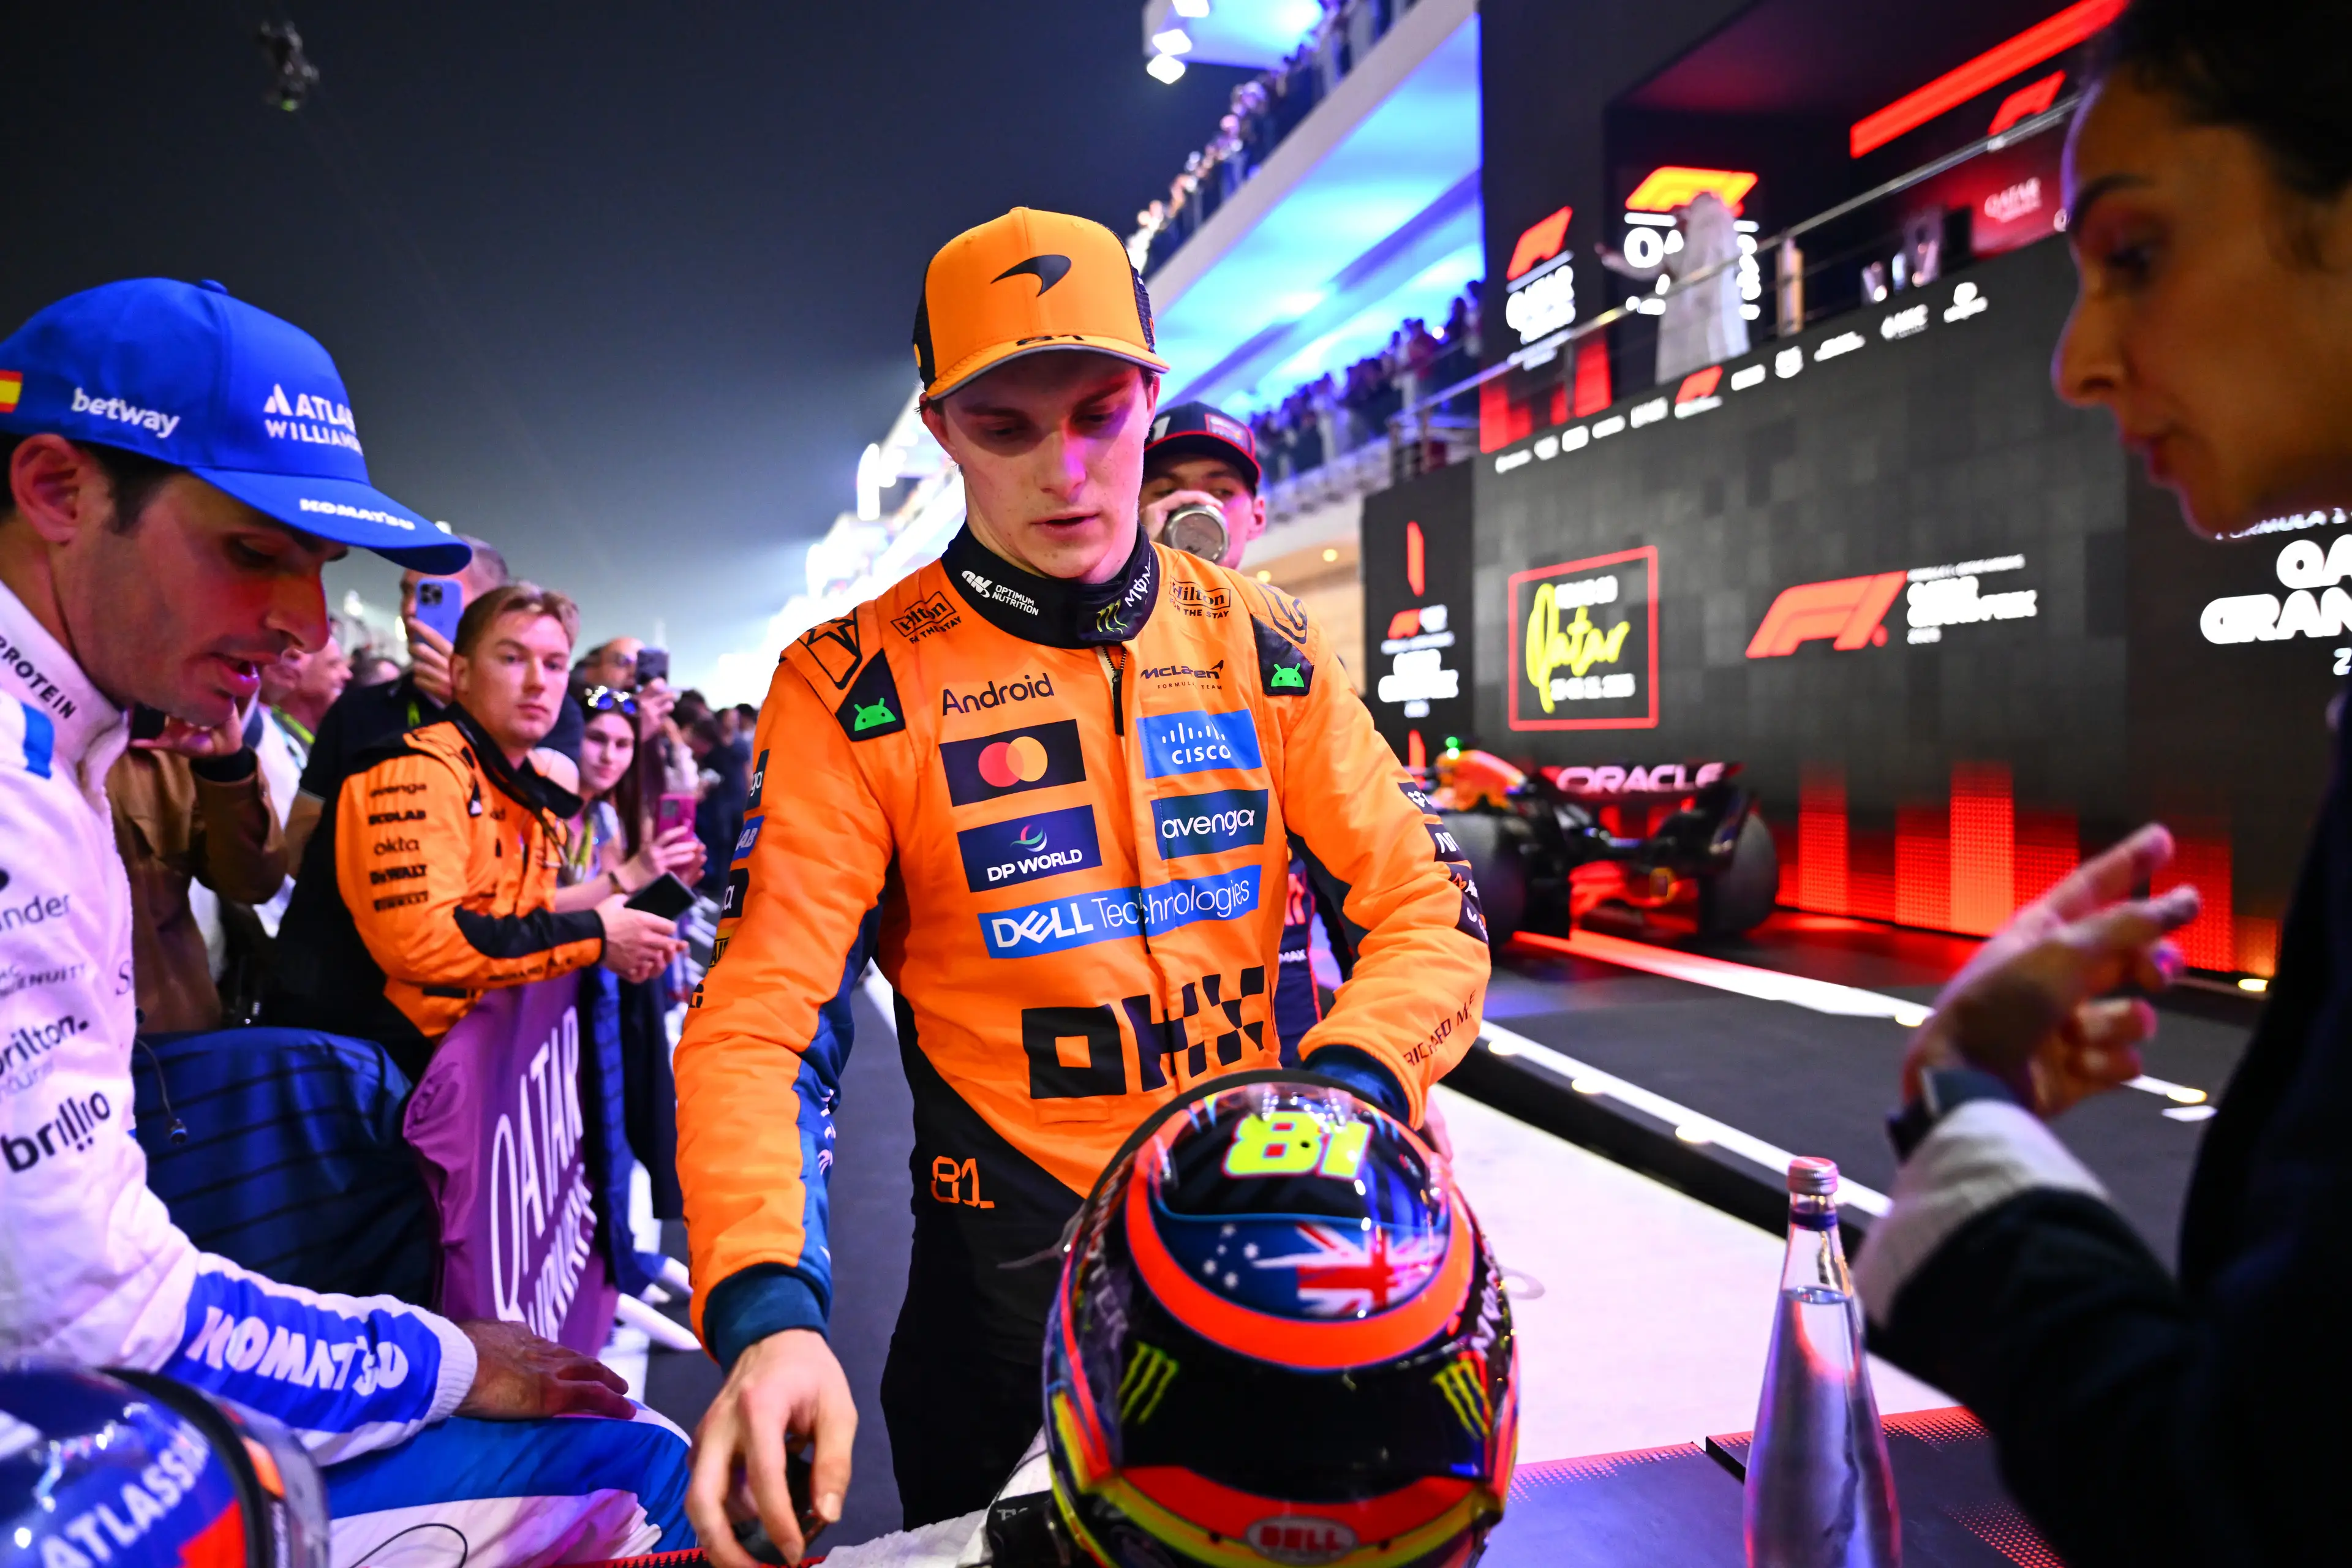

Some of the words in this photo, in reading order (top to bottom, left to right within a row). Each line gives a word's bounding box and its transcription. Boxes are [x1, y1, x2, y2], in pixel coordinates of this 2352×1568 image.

[71, 387, 181, 438] betway
[992, 592, 1039, 616] NUTRITION
[995, 584, 1035, 606] OPTIMUM
[1172, 582, 1225, 606] Hilton
[899, 603, 948, 631] Hlton
[940, 616, 962, 632] STAY
[1206, 610, 1229, 619] STAY
[942, 673, 1055, 717] Android
[1158, 681, 1194, 690] FORMUL
[1172, 745, 1231, 764] CISCO
[1556, 762, 1725, 794] ORACLE
[1162, 809, 1255, 839] avenga
[374, 837, 420, 856] okta
[987, 864, 1016, 882] DP
[1017, 849, 1083, 875] WORLD
[0, 895, 69, 931] nder
[991, 902, 1094, 949] DELL
[1223, 1110, 1373, 1182] 81
[491, 1006, 583, 1321] QATAR
[930, 1155, 995, 1209] 81
[40, 1420, 211, 1568] ATLASS
